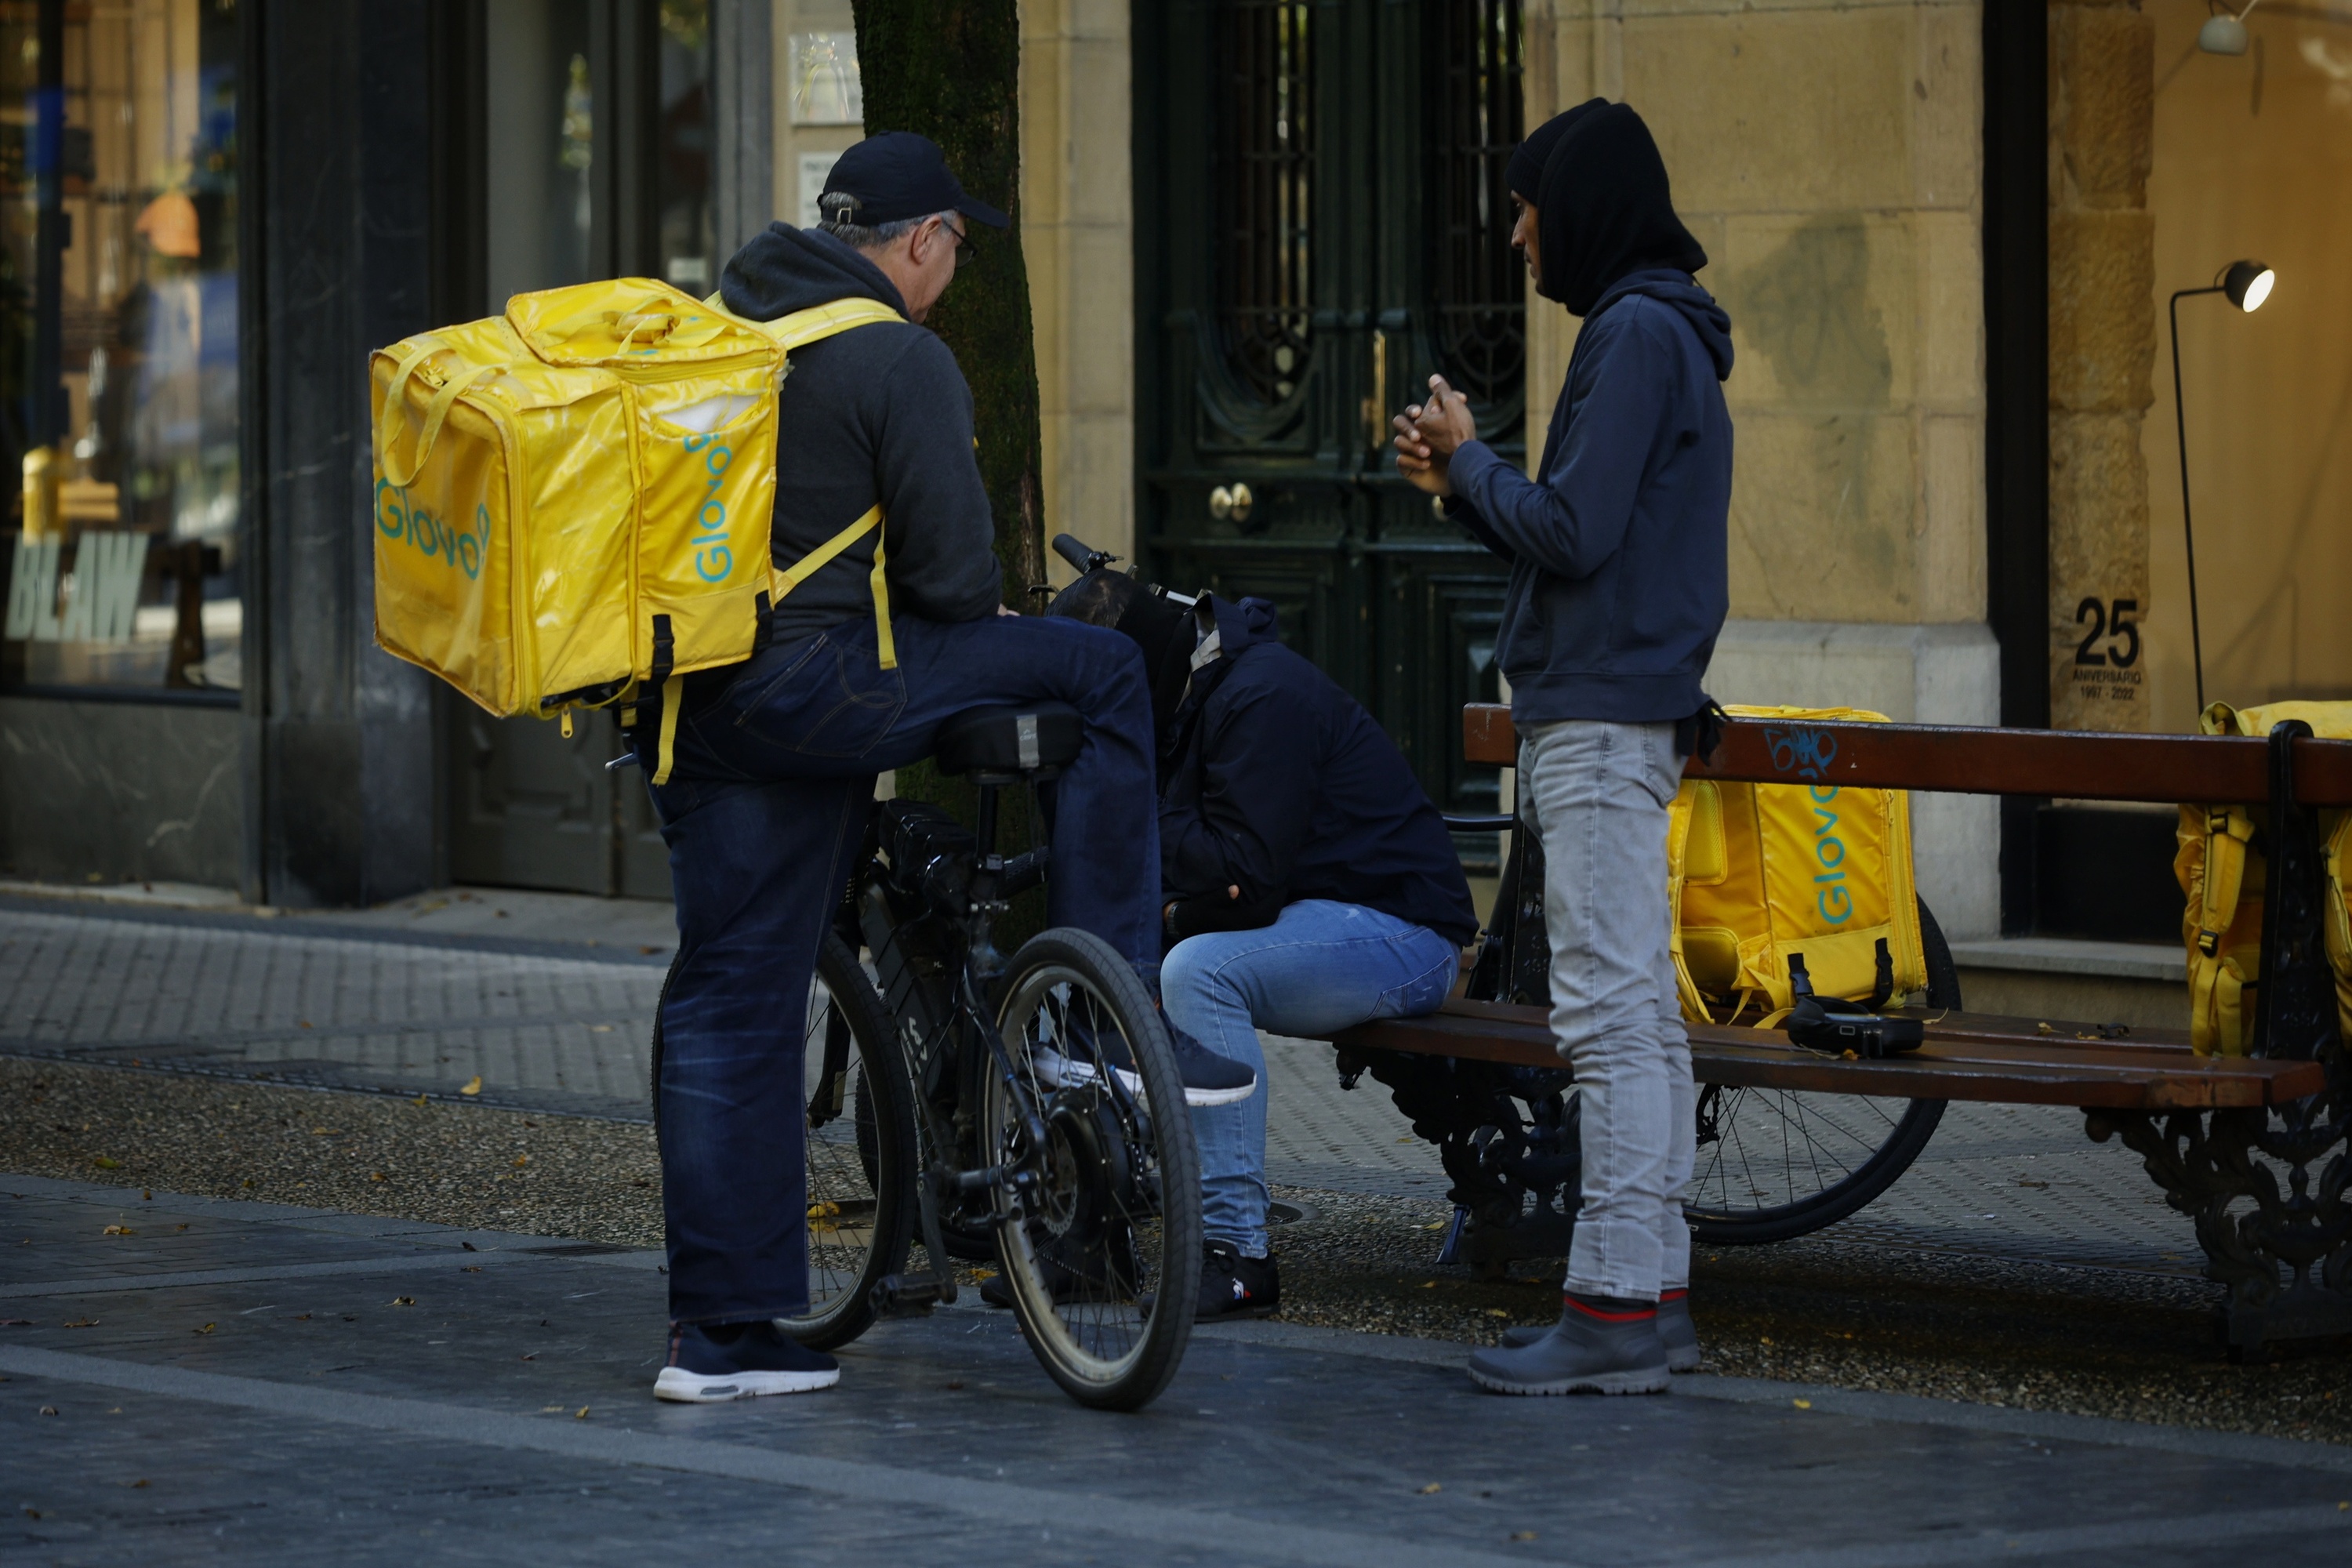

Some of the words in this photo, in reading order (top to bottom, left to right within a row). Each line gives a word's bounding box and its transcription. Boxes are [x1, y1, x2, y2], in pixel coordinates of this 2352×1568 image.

[376, 477, 481, 581] Glovo
[691, 445, 733, 583] Glovo
[2074, 596, 2140, 669] 25
[2073, 670, 2142, 684] ANIVERSARIO
[2111, 687, 2135, 702] 2022
